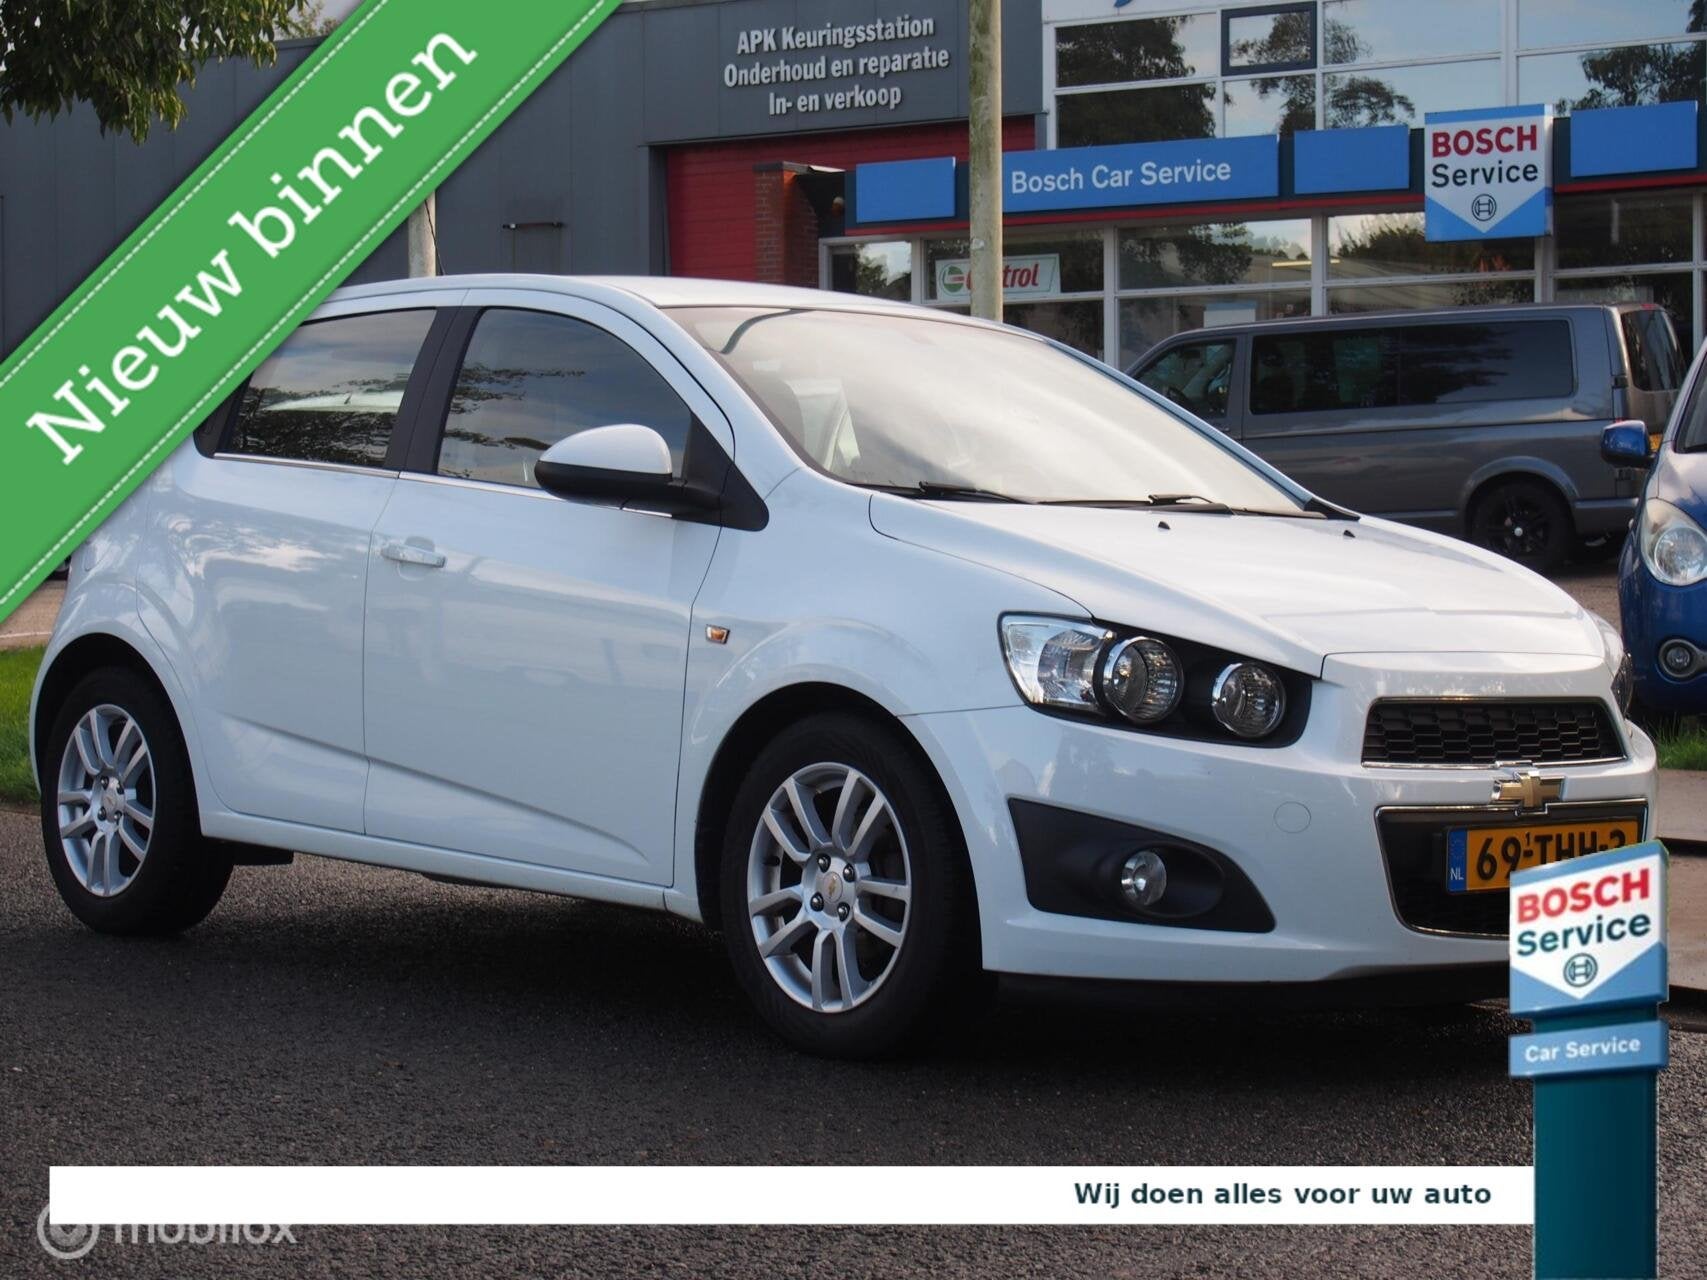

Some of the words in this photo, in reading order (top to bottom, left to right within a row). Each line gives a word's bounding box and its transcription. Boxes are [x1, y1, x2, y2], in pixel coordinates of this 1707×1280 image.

[737, 27, 777, 54] APK
[782, 15, 934, 49] Keuringsstation
[724, 56, 826, 87] Onderhoud
[831, 57, 853, 77] en
[859, 46, 949, 78] reparatie
[769, 92, 793, 115] In-
[797, 93, 819, 113] en
[824, 84, 902, 110] verkoop
[1432, 125, 1537, 158] BOSCH
[1011, 168, 1083, 194] Bosch
[1091, 165, 1133, 189] Car
[1140, 159, 1232, 186] Service
[1432, 160, 1538, 188] Service
[1450, 868, 1464, 881] NL
